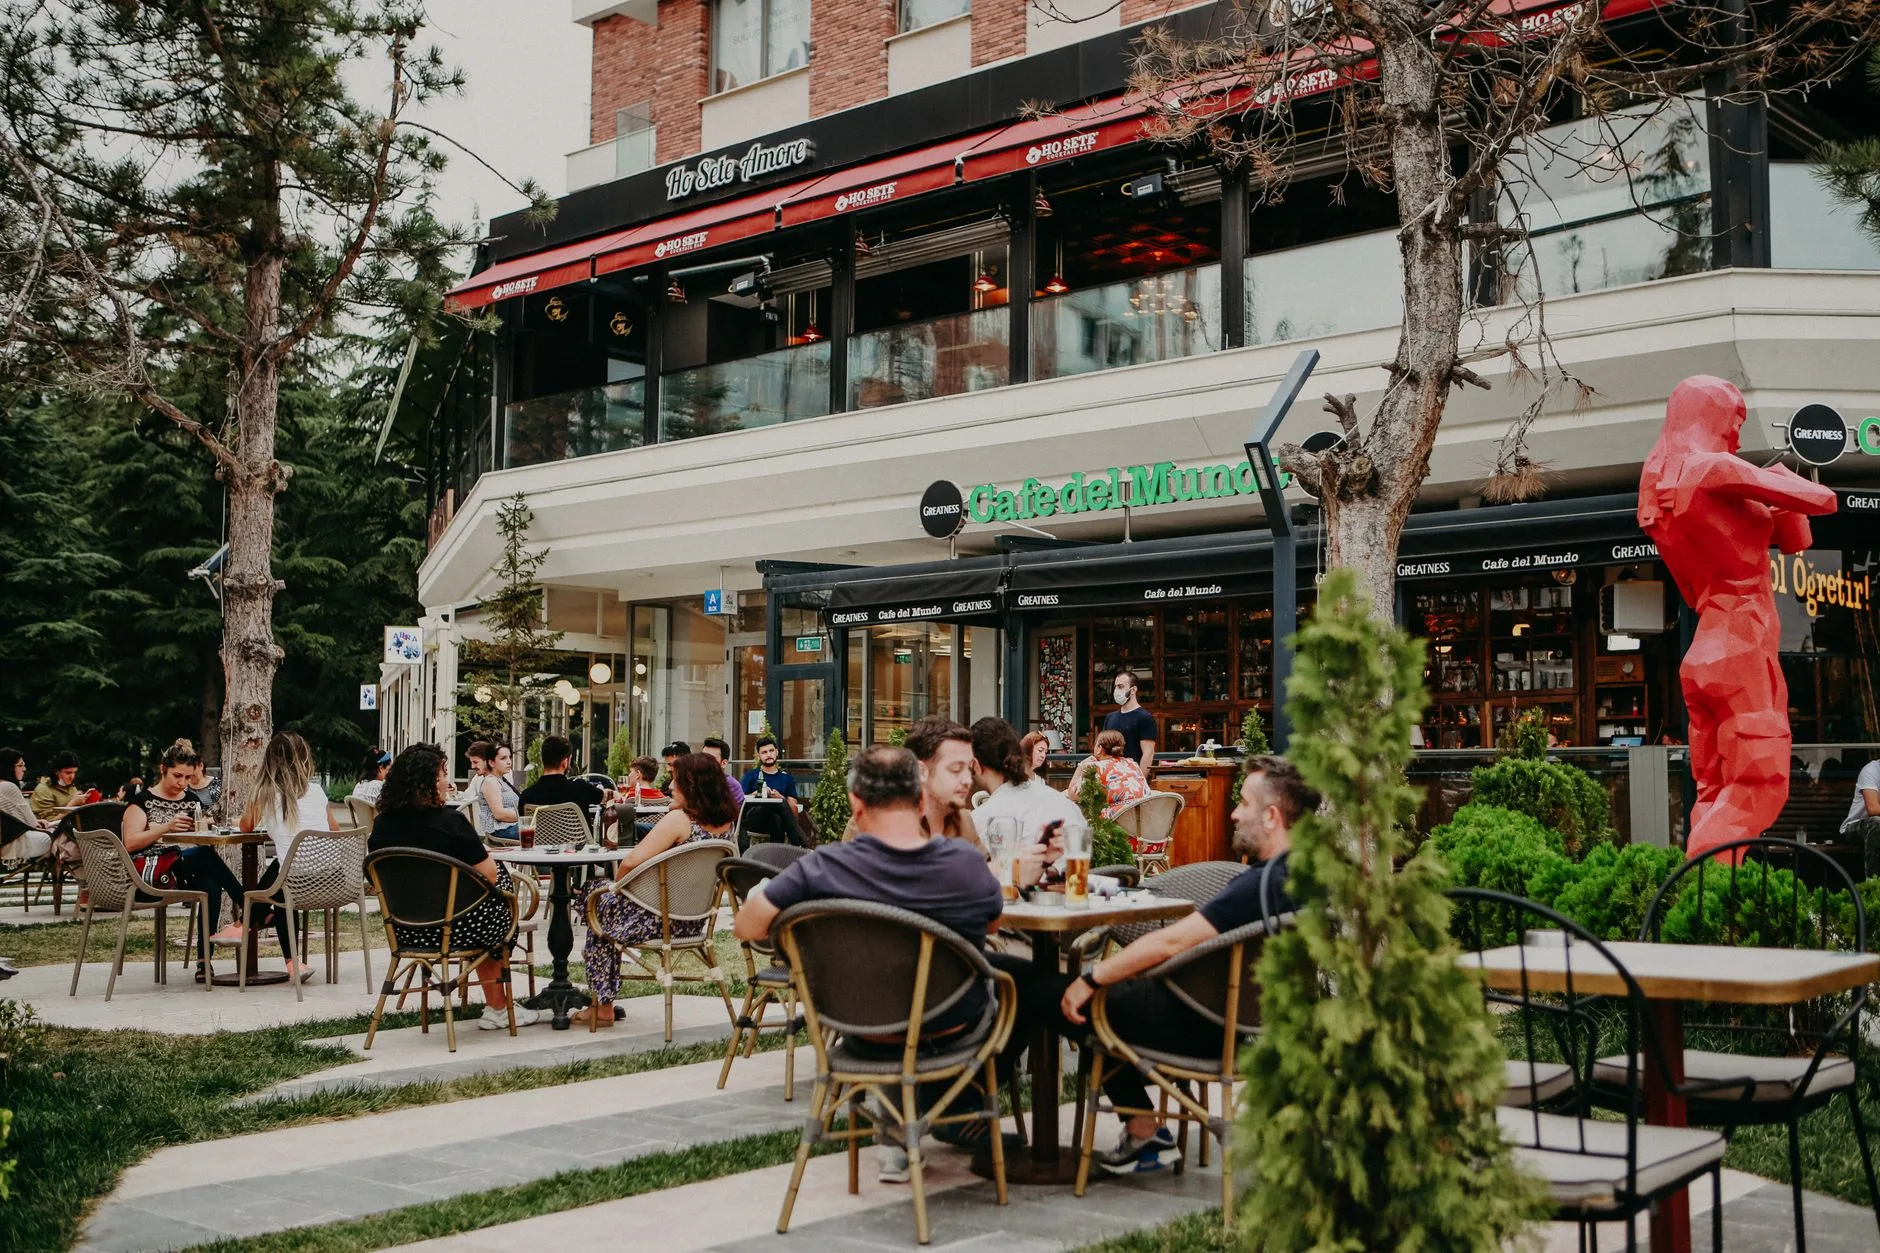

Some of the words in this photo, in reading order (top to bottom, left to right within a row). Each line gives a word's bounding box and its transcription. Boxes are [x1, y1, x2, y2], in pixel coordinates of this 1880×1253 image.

[1041, 141, 1062, 156] HO
[1063, 133, 1096, 150] SETE
[1046, 148, 1078, 160] COCKTAIL
[665, 163, 693, 200] Ho
[695, 155, 735, 191] Sete
[739, 138, 808, 182] Amore
[847, 190, 866, 204] HO
[867, 182, 896, 199] SETE
[666, 238, 681, 251] HO
[682, 232, 707, 246] SETE
[503, 282, 515, 293] HO
[968, 477, 1056, 523] Cafe
[1060, 467, 1124, 513] del
[1482, 558, 1509, 570] Cafe
[1511, 556, 1531, 568] del
[1533, 552, 1579, 566] Mundo
[709, 592, 717, 605] A
[1144, 588, 1166, 599] Cafe
[1167, 587, 1183, 598] del
[1184, 584, 1222, 596] Mundo
[878, 609, 896, 620] Cafe
[897, 608, 910, 618] del
[911, 605, 942, 617] Mundo
